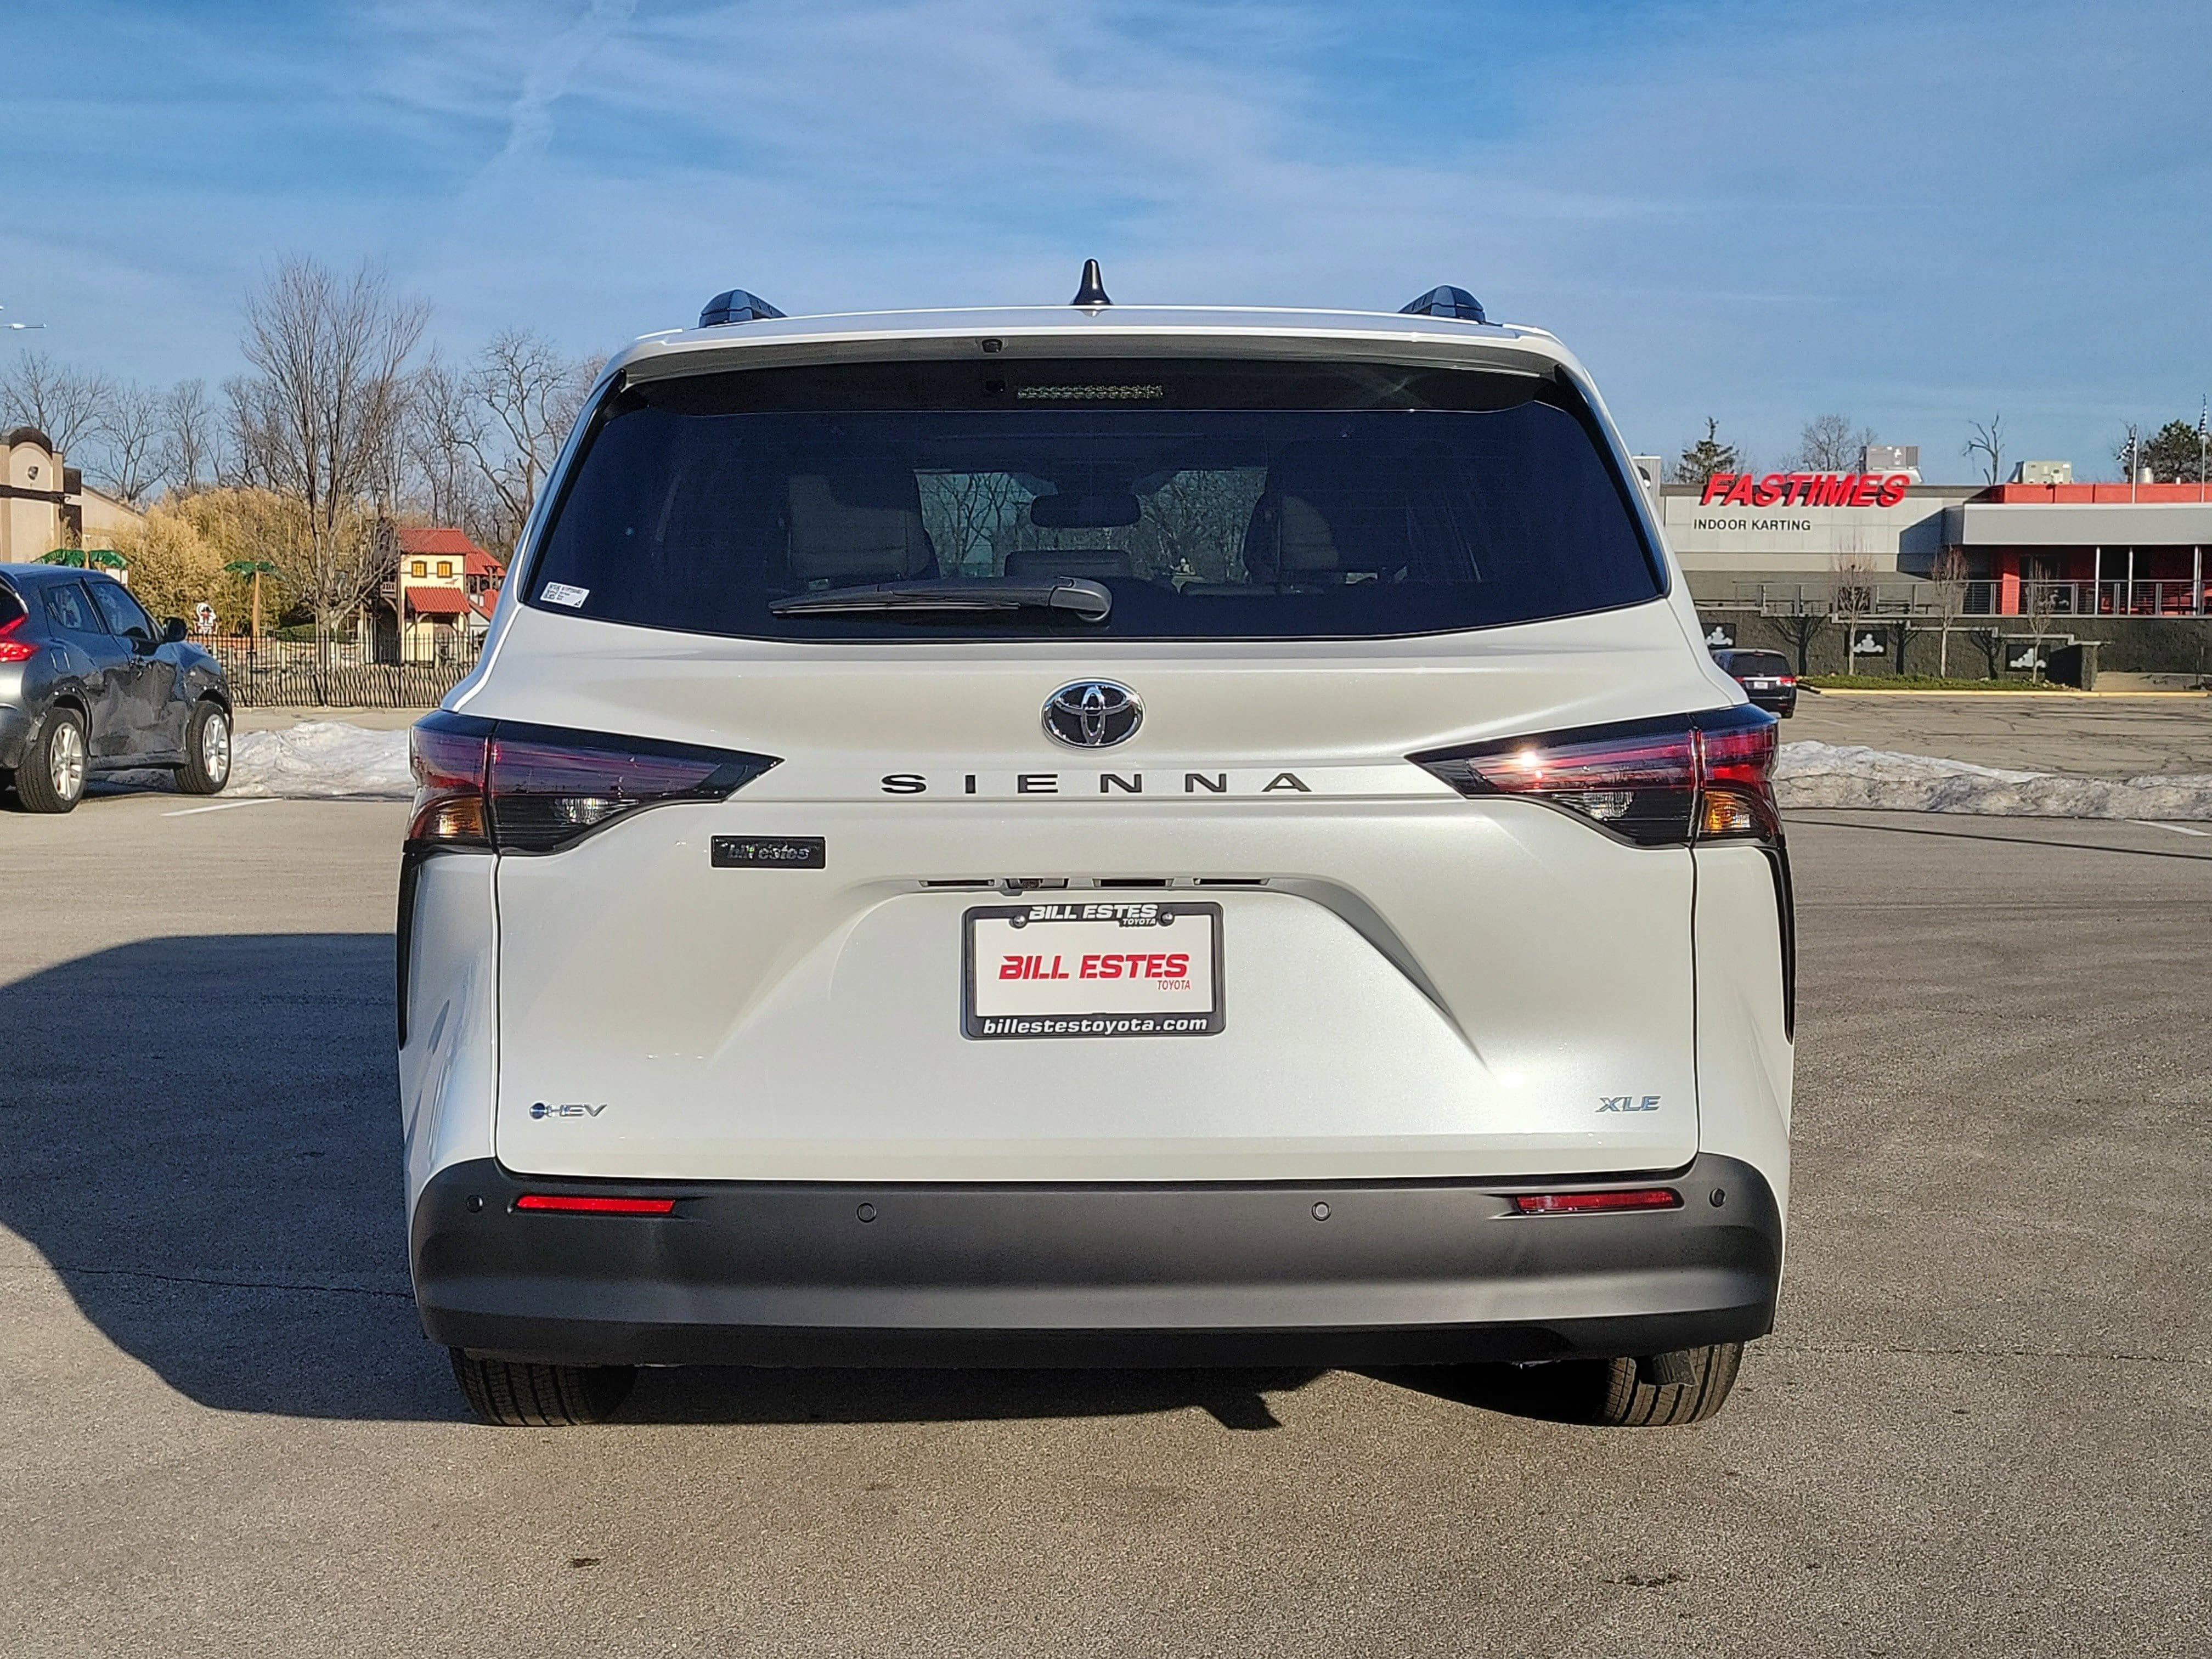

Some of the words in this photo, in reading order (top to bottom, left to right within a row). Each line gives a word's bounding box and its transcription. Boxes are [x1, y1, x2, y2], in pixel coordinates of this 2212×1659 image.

[1700, 473, 1910, 507] FASTIMES
[1694, 519, 1746, 530] INDOOR
[1752, 519, 1811, 531] KARTING
[881, 772, 1312, 793] SIENNA
[1028, 906, 1077, 920] BILL
[1082, 904, 1158, 919] ESTES
[998, 955, 1069, 980] BILL
[1079, 953, 1189, 979] ESTES
[1157, 980, 1190, 990] TOYOTA
[984, 1018, 1207, 1036] billestestoyota.com
[546, 1104, 607, 1117] HEV
[1595, 1096, 1661, 1112] XLE
